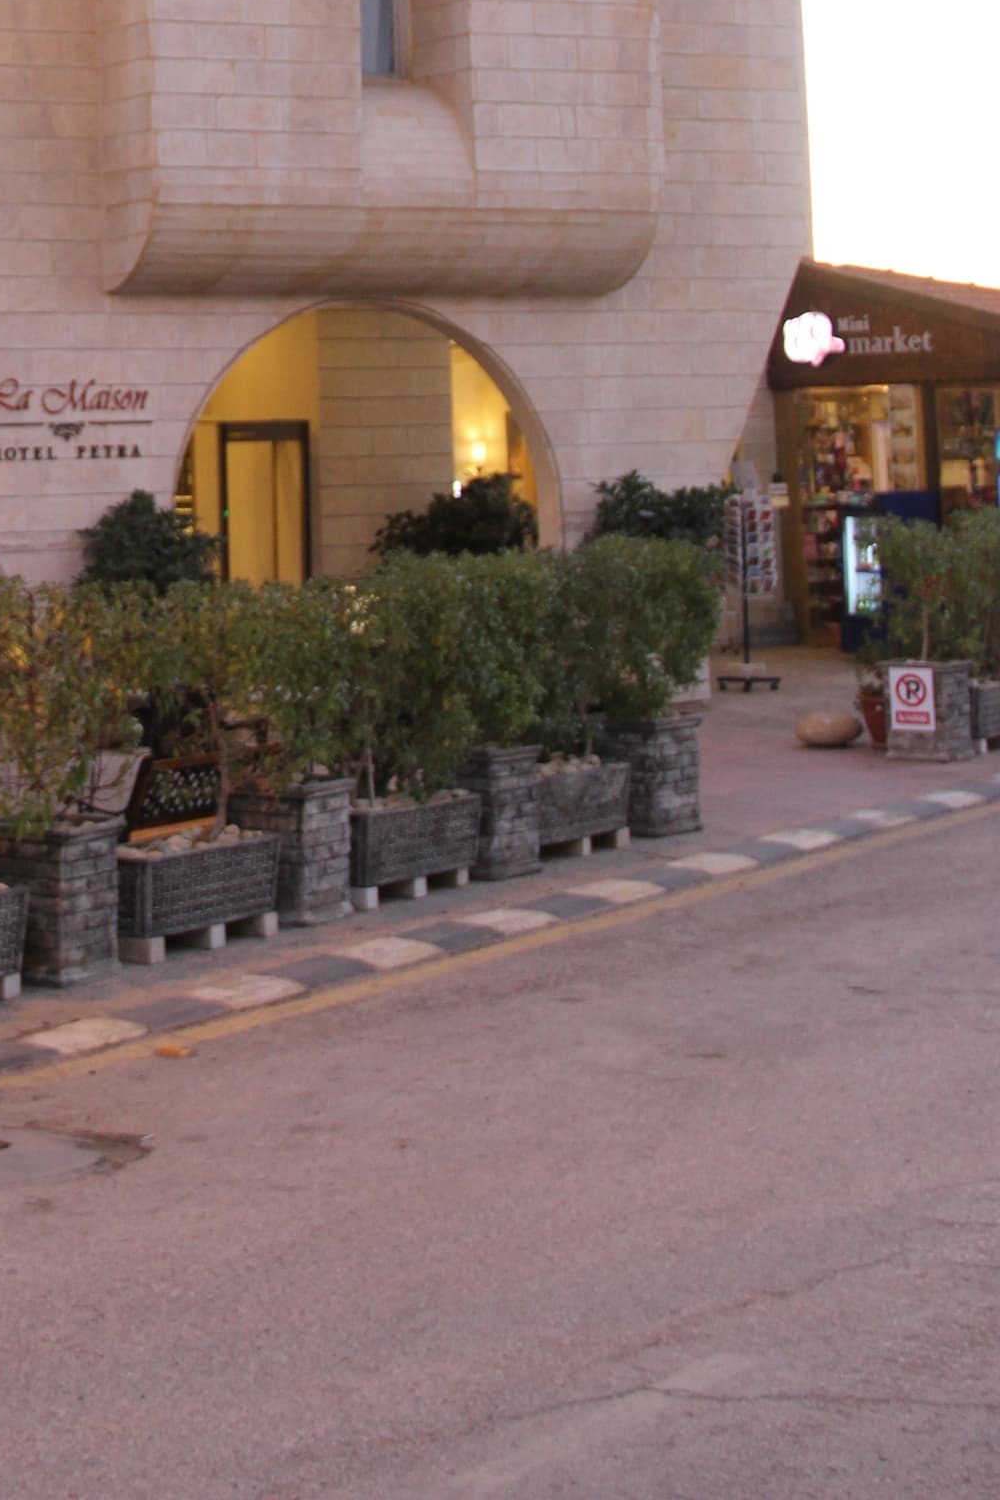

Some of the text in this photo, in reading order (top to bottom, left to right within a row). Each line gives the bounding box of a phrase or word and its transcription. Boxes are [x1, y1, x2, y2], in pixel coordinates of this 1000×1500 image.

[837, 314, 870, 332] Mini
[848, 326, 934, 354] market
[41, 379, 149, 414] Maison
[75, 444, 142, 460] PETRA
